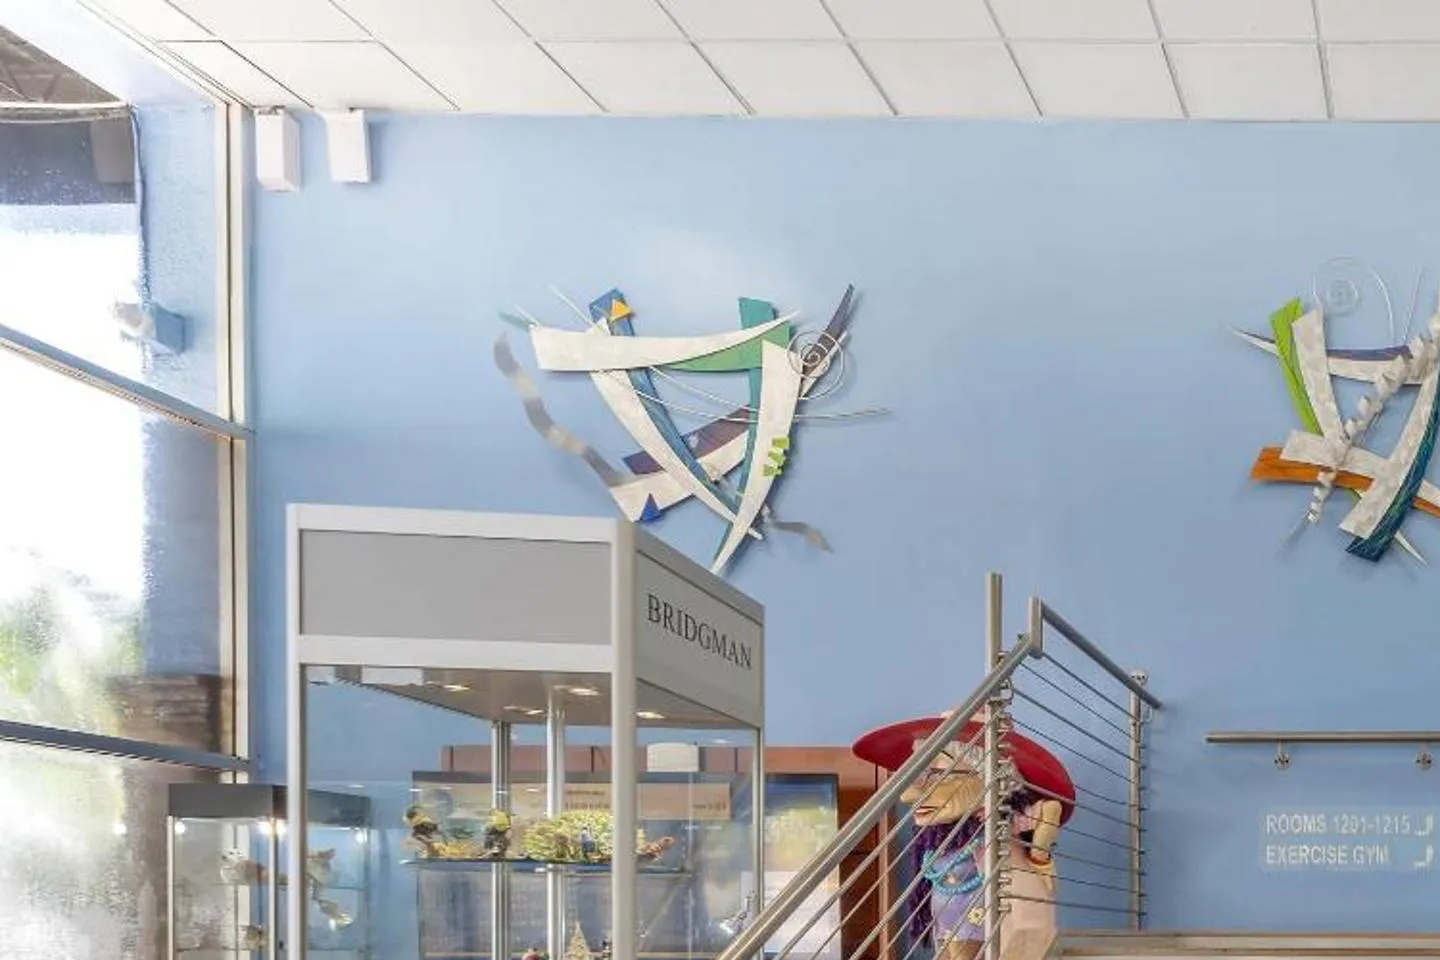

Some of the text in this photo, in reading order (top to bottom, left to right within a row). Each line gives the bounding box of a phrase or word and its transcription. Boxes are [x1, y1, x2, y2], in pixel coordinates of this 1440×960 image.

[647, 593, 752, 669] BRIDGMAN
[1266, 813, 1410, 834] ROOMS 1201-1215
[1266, 846, 1389, 864] EXERCISE GYM
